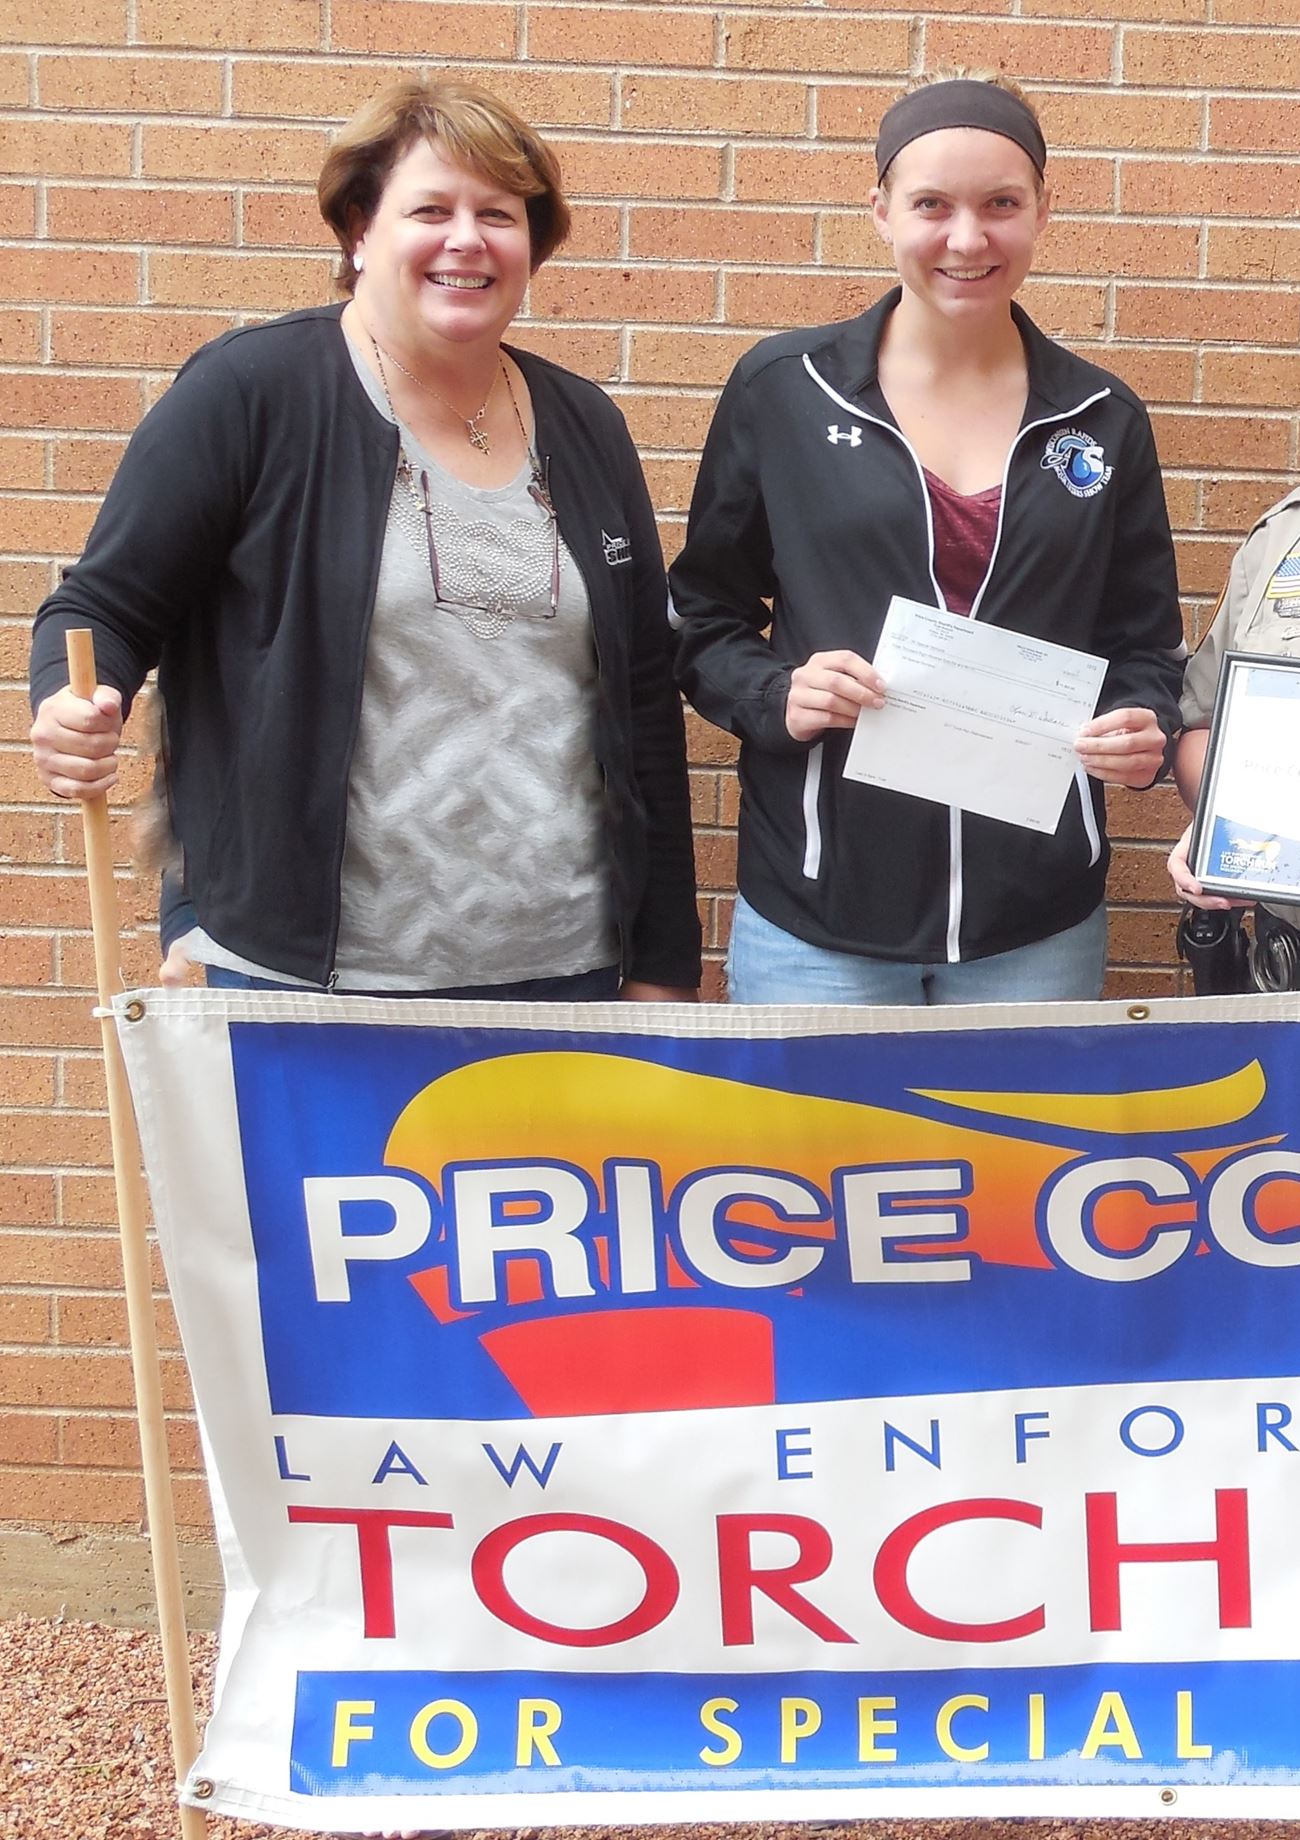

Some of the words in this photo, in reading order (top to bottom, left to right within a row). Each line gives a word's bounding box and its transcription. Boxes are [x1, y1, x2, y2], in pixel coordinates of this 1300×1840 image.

[1083, 482, 1104, 498] SHOW
[1100, 465, 1116, 485] TEAM
[1220, 854, 1255, 869] TORCH
[303, 1165, 974, 1304] PRICE
[274, 1435, 564, 1488] LAW
[286, 1486, 1253, 1648] TORCH
[330, 1697, 563, 1769] FOR
[698, 1690, 1214, 1767] SPECIAL
